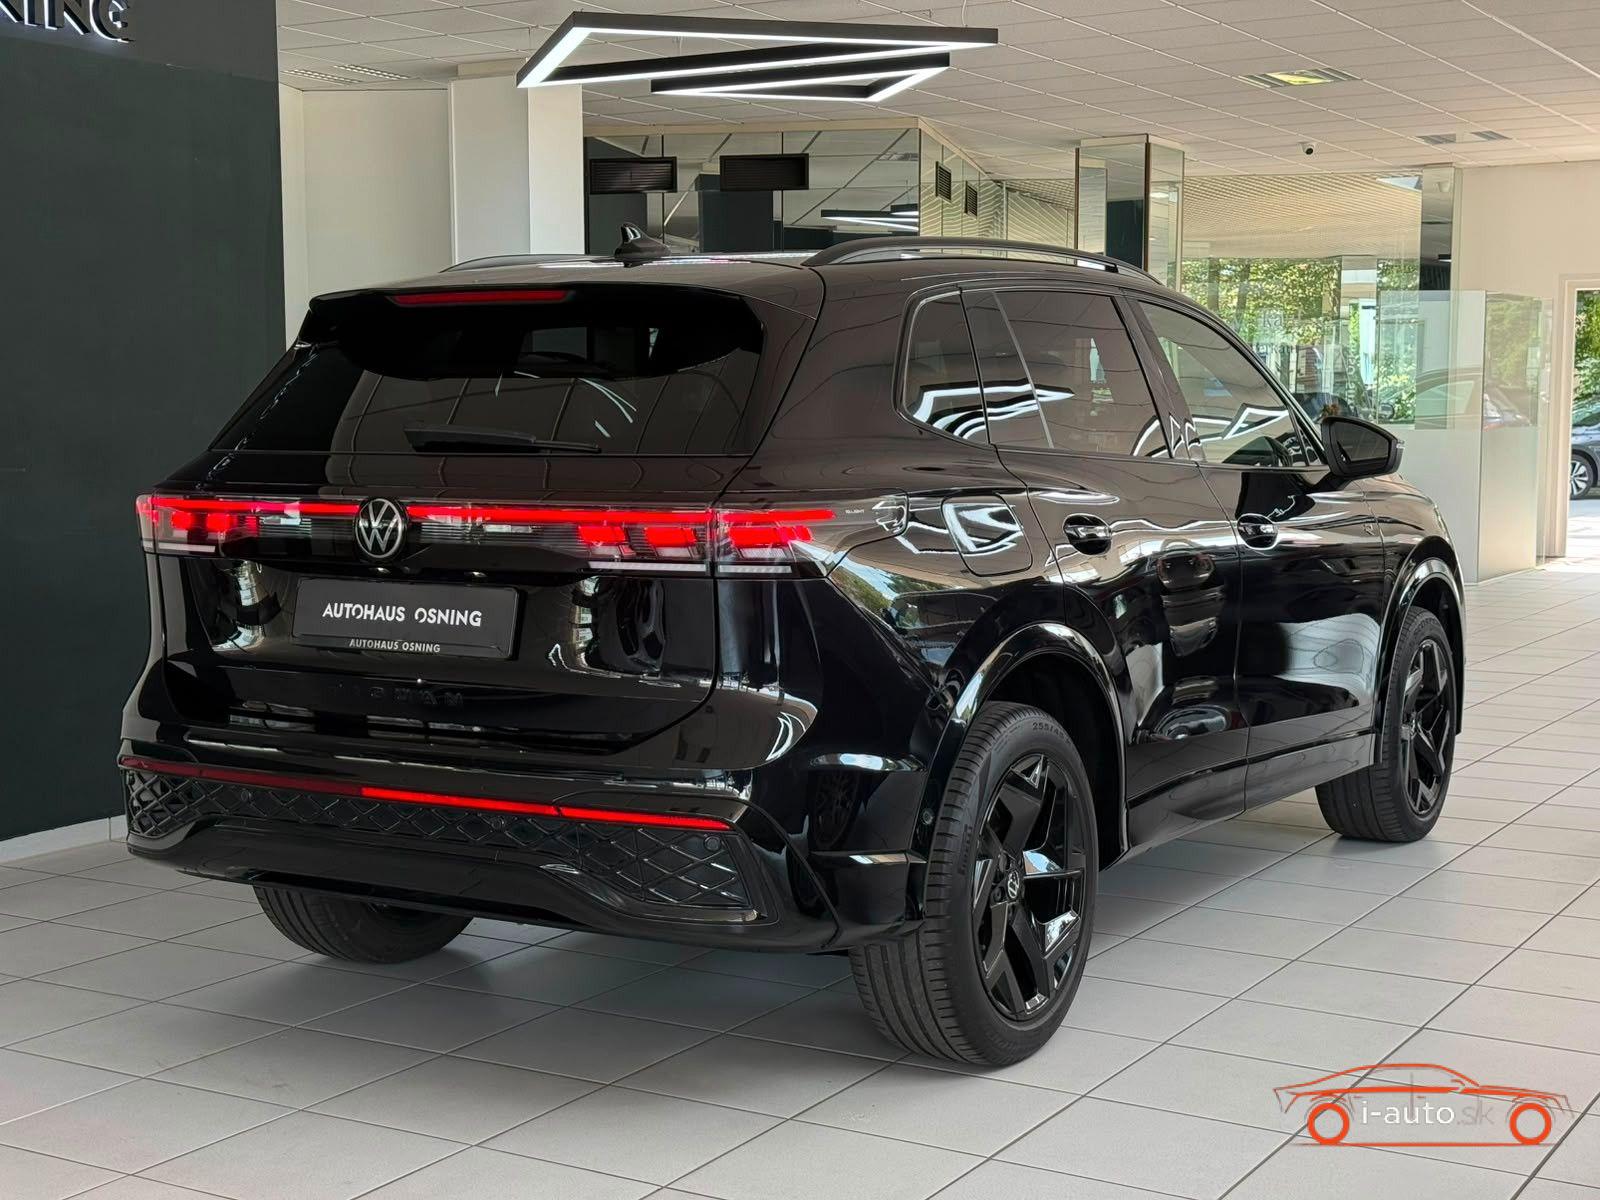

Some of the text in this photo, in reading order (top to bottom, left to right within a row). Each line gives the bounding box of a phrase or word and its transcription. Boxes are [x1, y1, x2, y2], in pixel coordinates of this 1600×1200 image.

[322, 602, 482, 627] AUTOHAUS OSNING
[349, 638, 441, 653] AUTOHAUS OSNING
